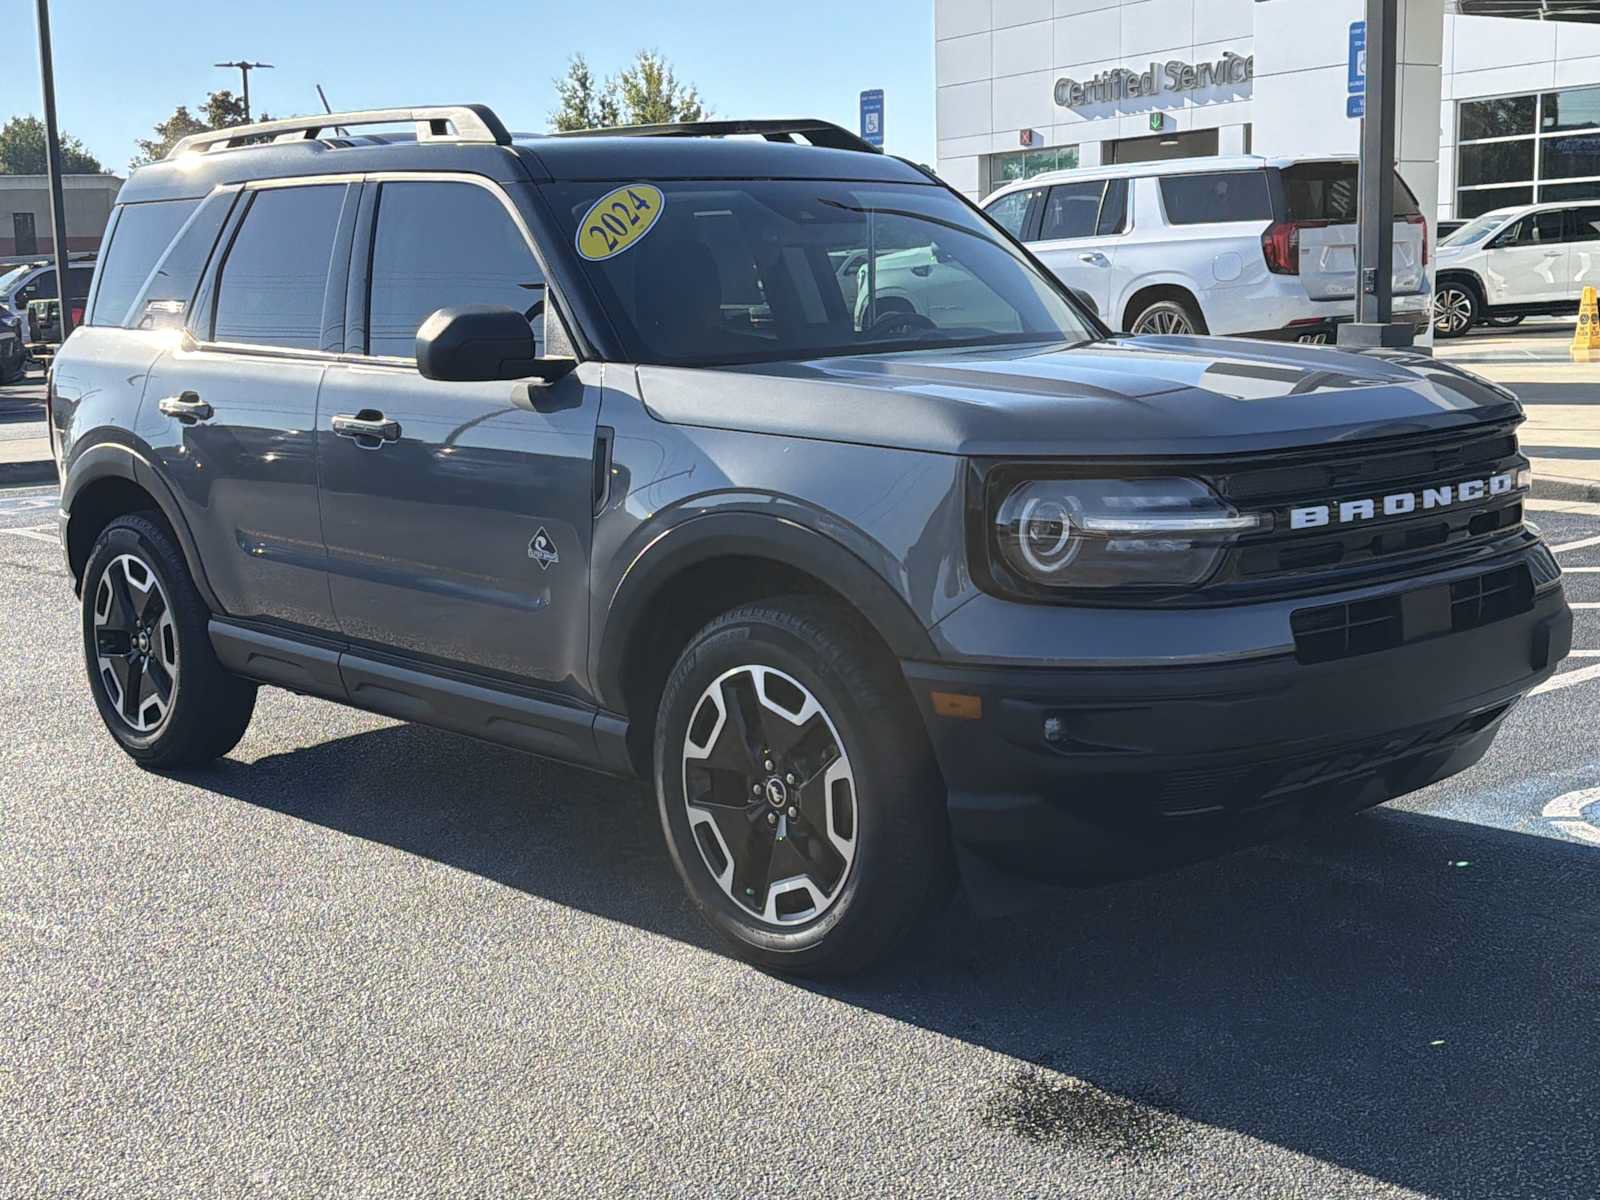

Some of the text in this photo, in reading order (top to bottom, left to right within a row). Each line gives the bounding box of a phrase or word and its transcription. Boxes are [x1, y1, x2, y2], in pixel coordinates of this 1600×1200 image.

[1054, 62, 1161, 108] Certified
[589, 189, 651, 252] 2024
[1290, 474, 1512, 530] BRONCO
